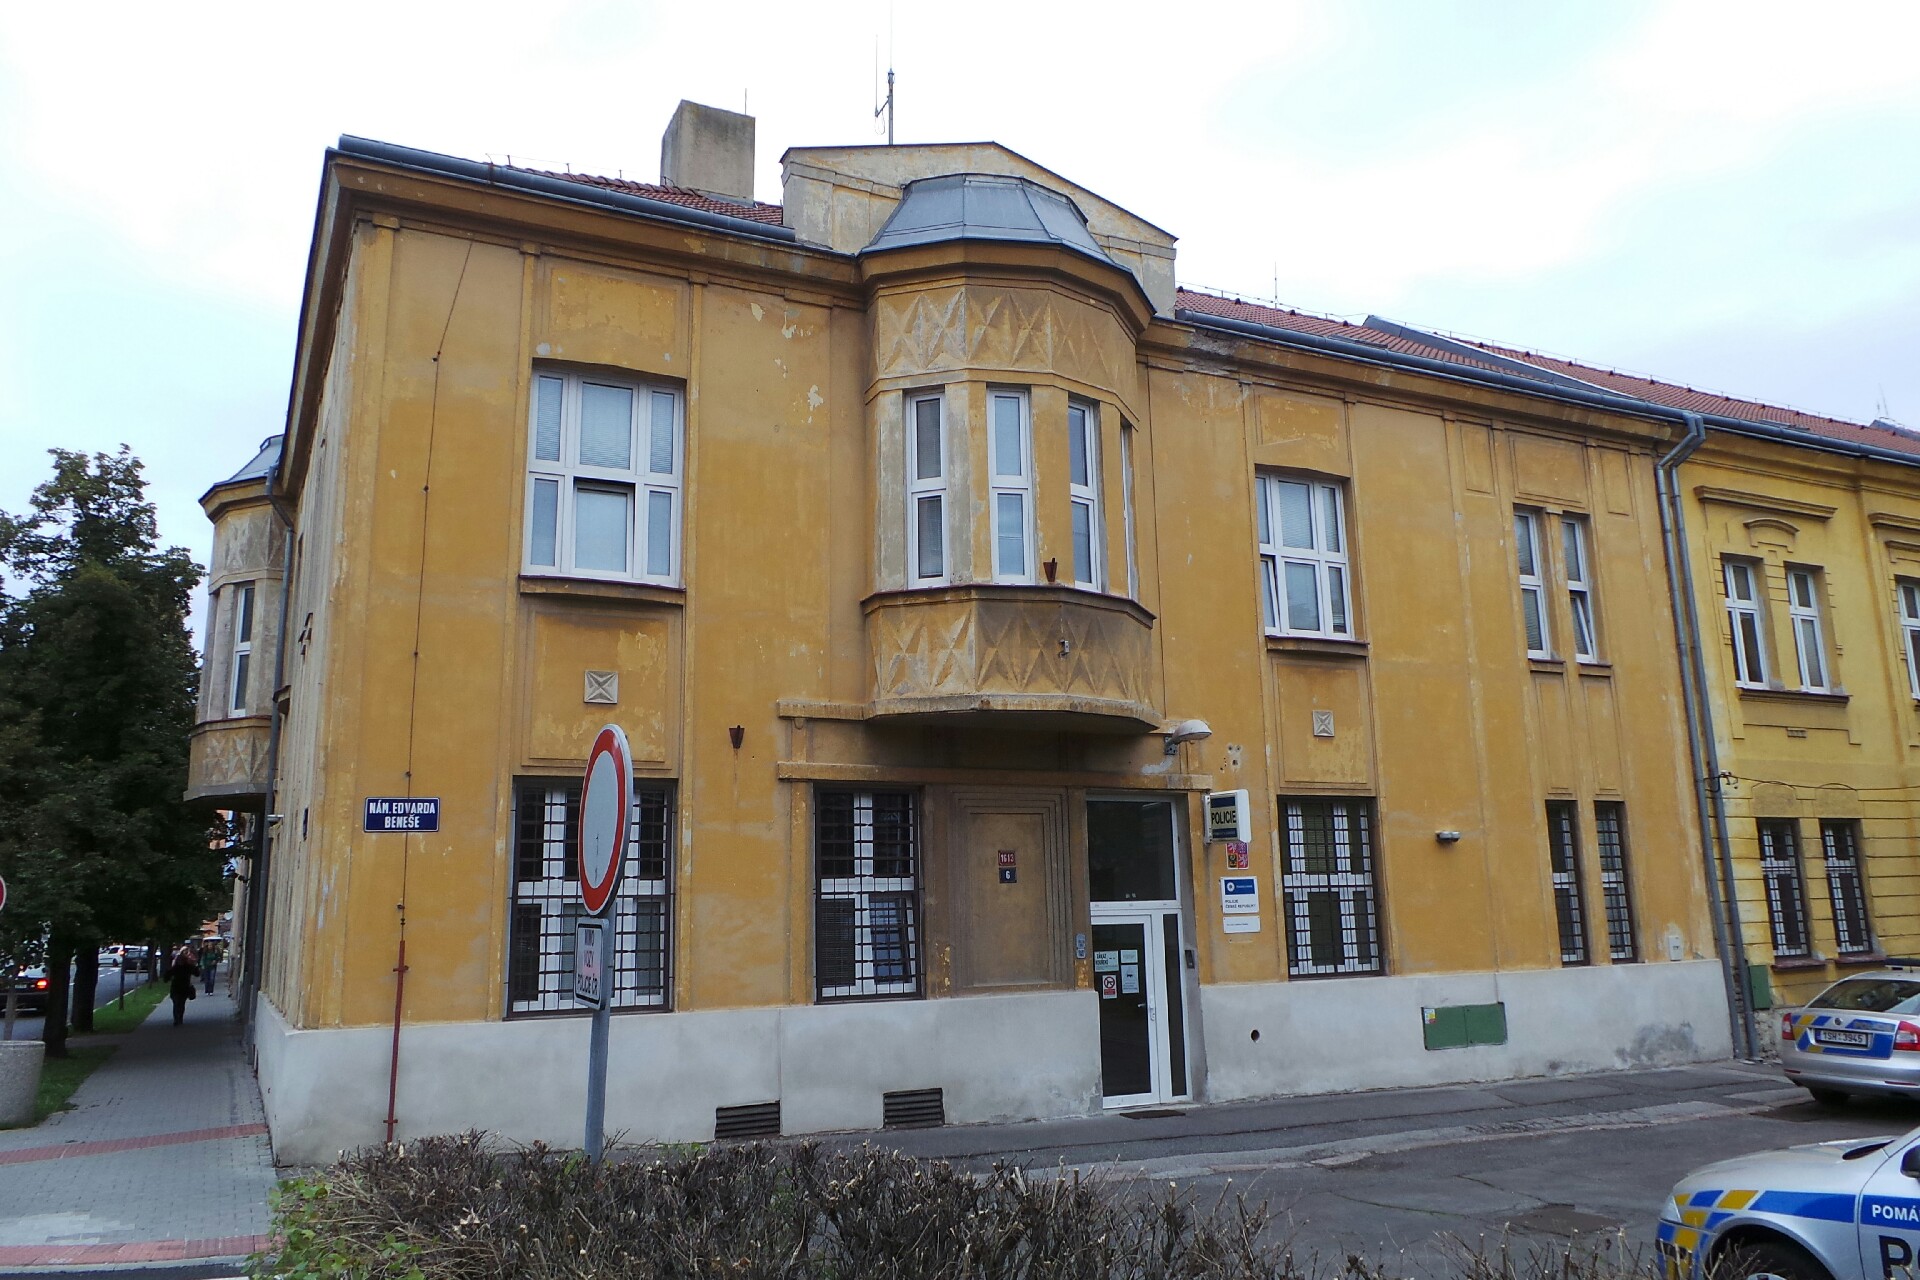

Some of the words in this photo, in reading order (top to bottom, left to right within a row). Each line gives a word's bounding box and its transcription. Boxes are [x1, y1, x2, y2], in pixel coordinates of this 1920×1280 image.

[369, 800, 391, 814] NÁM.
[392, 802, 436, 814] EDVARDA
[384, 814, 420, 829] BENEŠE
[1211, 810, 1236, 825] POLICIE
[1005, 870, 1011, 880] 6
[1872, 1204, 1920, 1222] POMÁ
[1878, 1235, 1920, 1280] P
